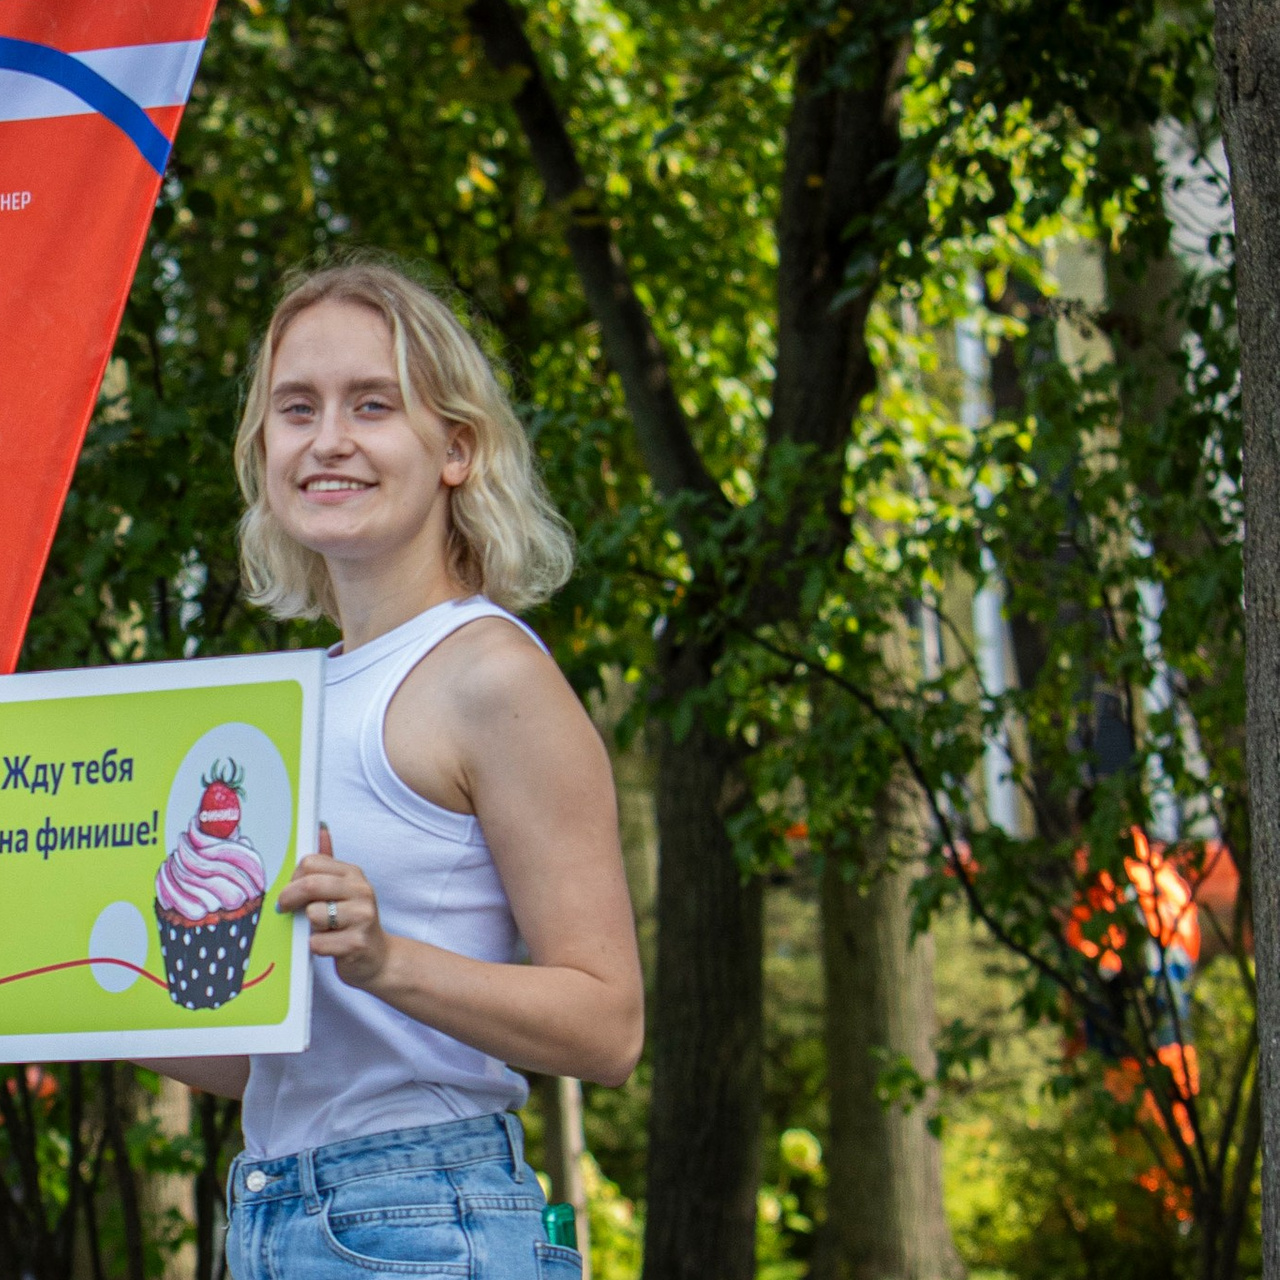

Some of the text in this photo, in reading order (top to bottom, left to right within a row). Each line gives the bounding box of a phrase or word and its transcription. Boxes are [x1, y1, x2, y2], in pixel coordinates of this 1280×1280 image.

[0, 748, 134, 795] Жду тебя
[35, 810, 159, 860] финише!
